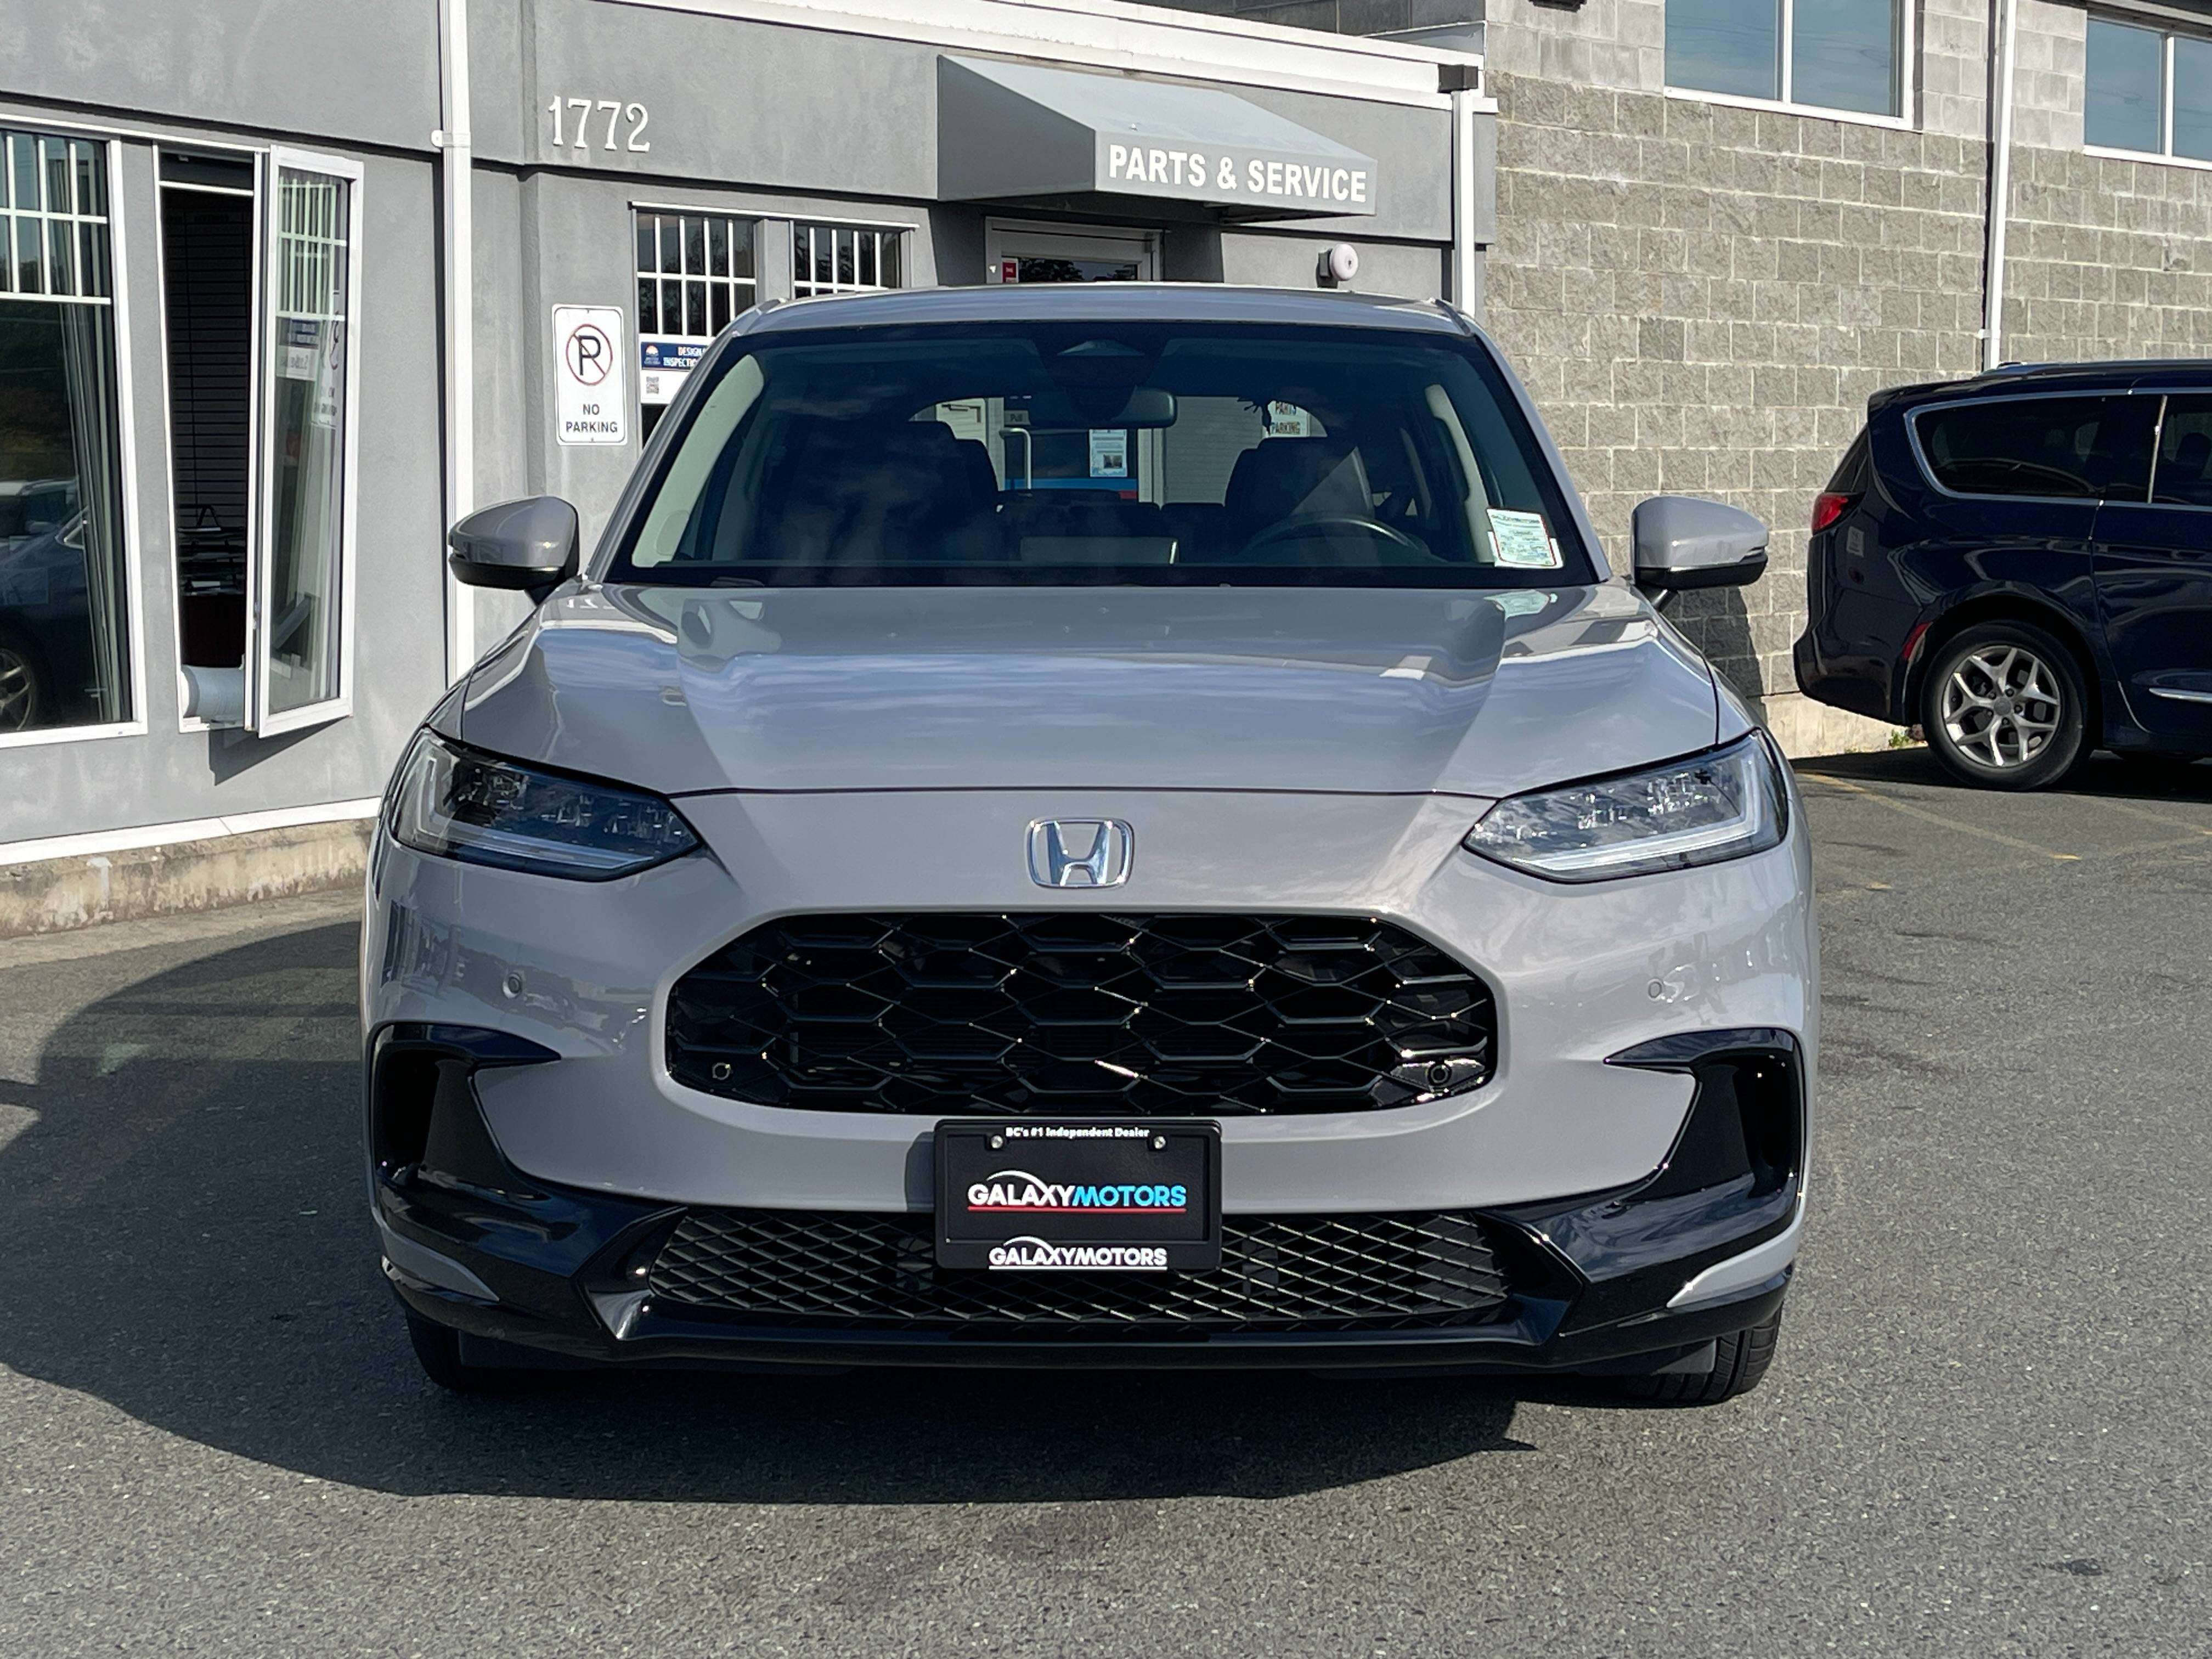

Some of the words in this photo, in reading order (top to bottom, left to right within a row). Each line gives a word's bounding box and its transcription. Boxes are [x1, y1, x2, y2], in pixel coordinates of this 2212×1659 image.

[548, 95, 650, 153] 1772
[1108, 144, 1207, 187] PARTS
[1216, 156, 1238, 190] &
[1247, 159, 1367, 203] SERVICE
[583, 403, 600, 415] NO
[566, 420, 618, 433] PARKING
[1046, 1127, 1113, 1139] Independent
[1114, 1127, 1150, 1138] Dealer
